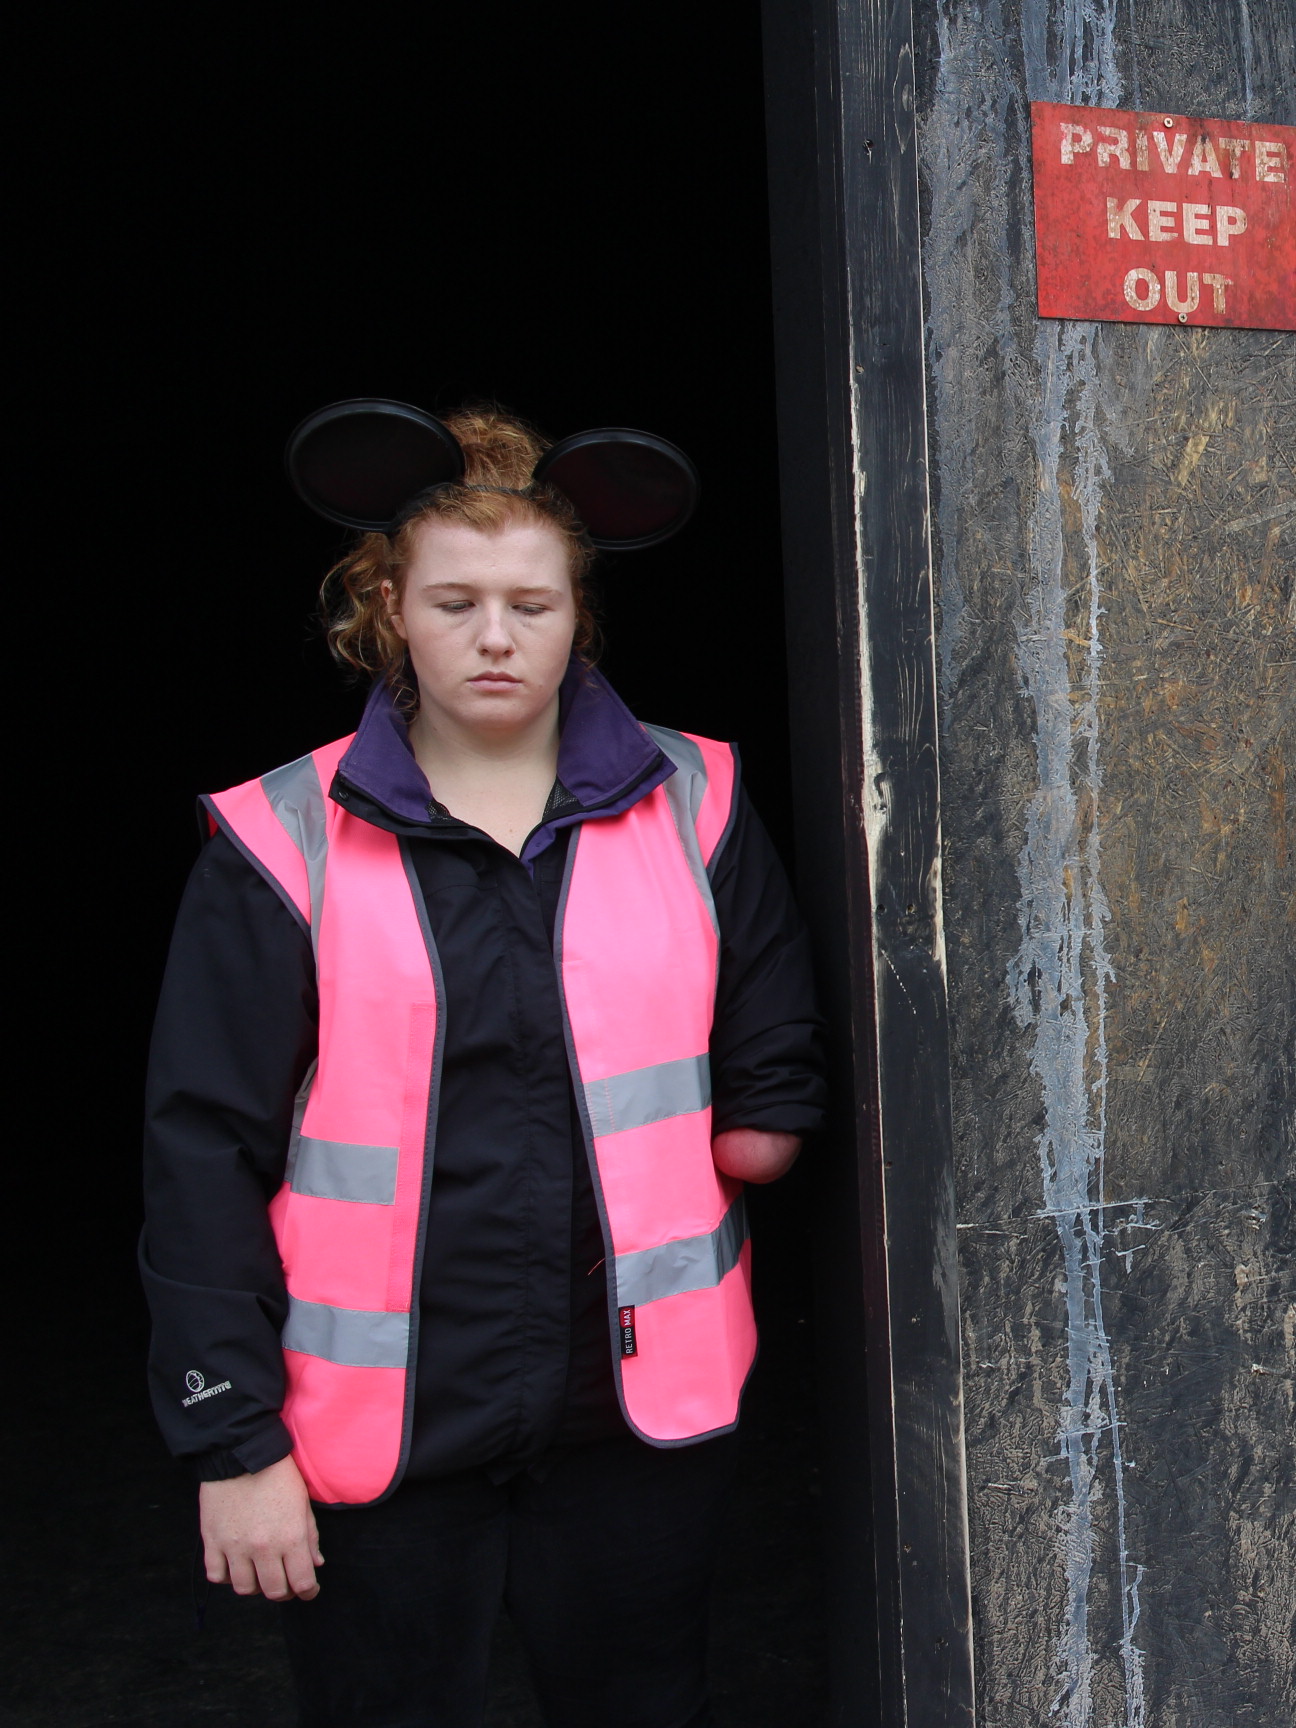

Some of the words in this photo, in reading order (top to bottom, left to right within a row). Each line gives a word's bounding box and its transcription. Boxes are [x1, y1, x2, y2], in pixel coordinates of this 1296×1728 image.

[1060, 122, 1288, 183] PRIVATE
[1106, 196, 1248, 247] KEEP
[1123, 267, 1234, 314] OUT
[623, 1309, 631, 1326] MAX
[624, 1327, 633, 1354] RETRO
